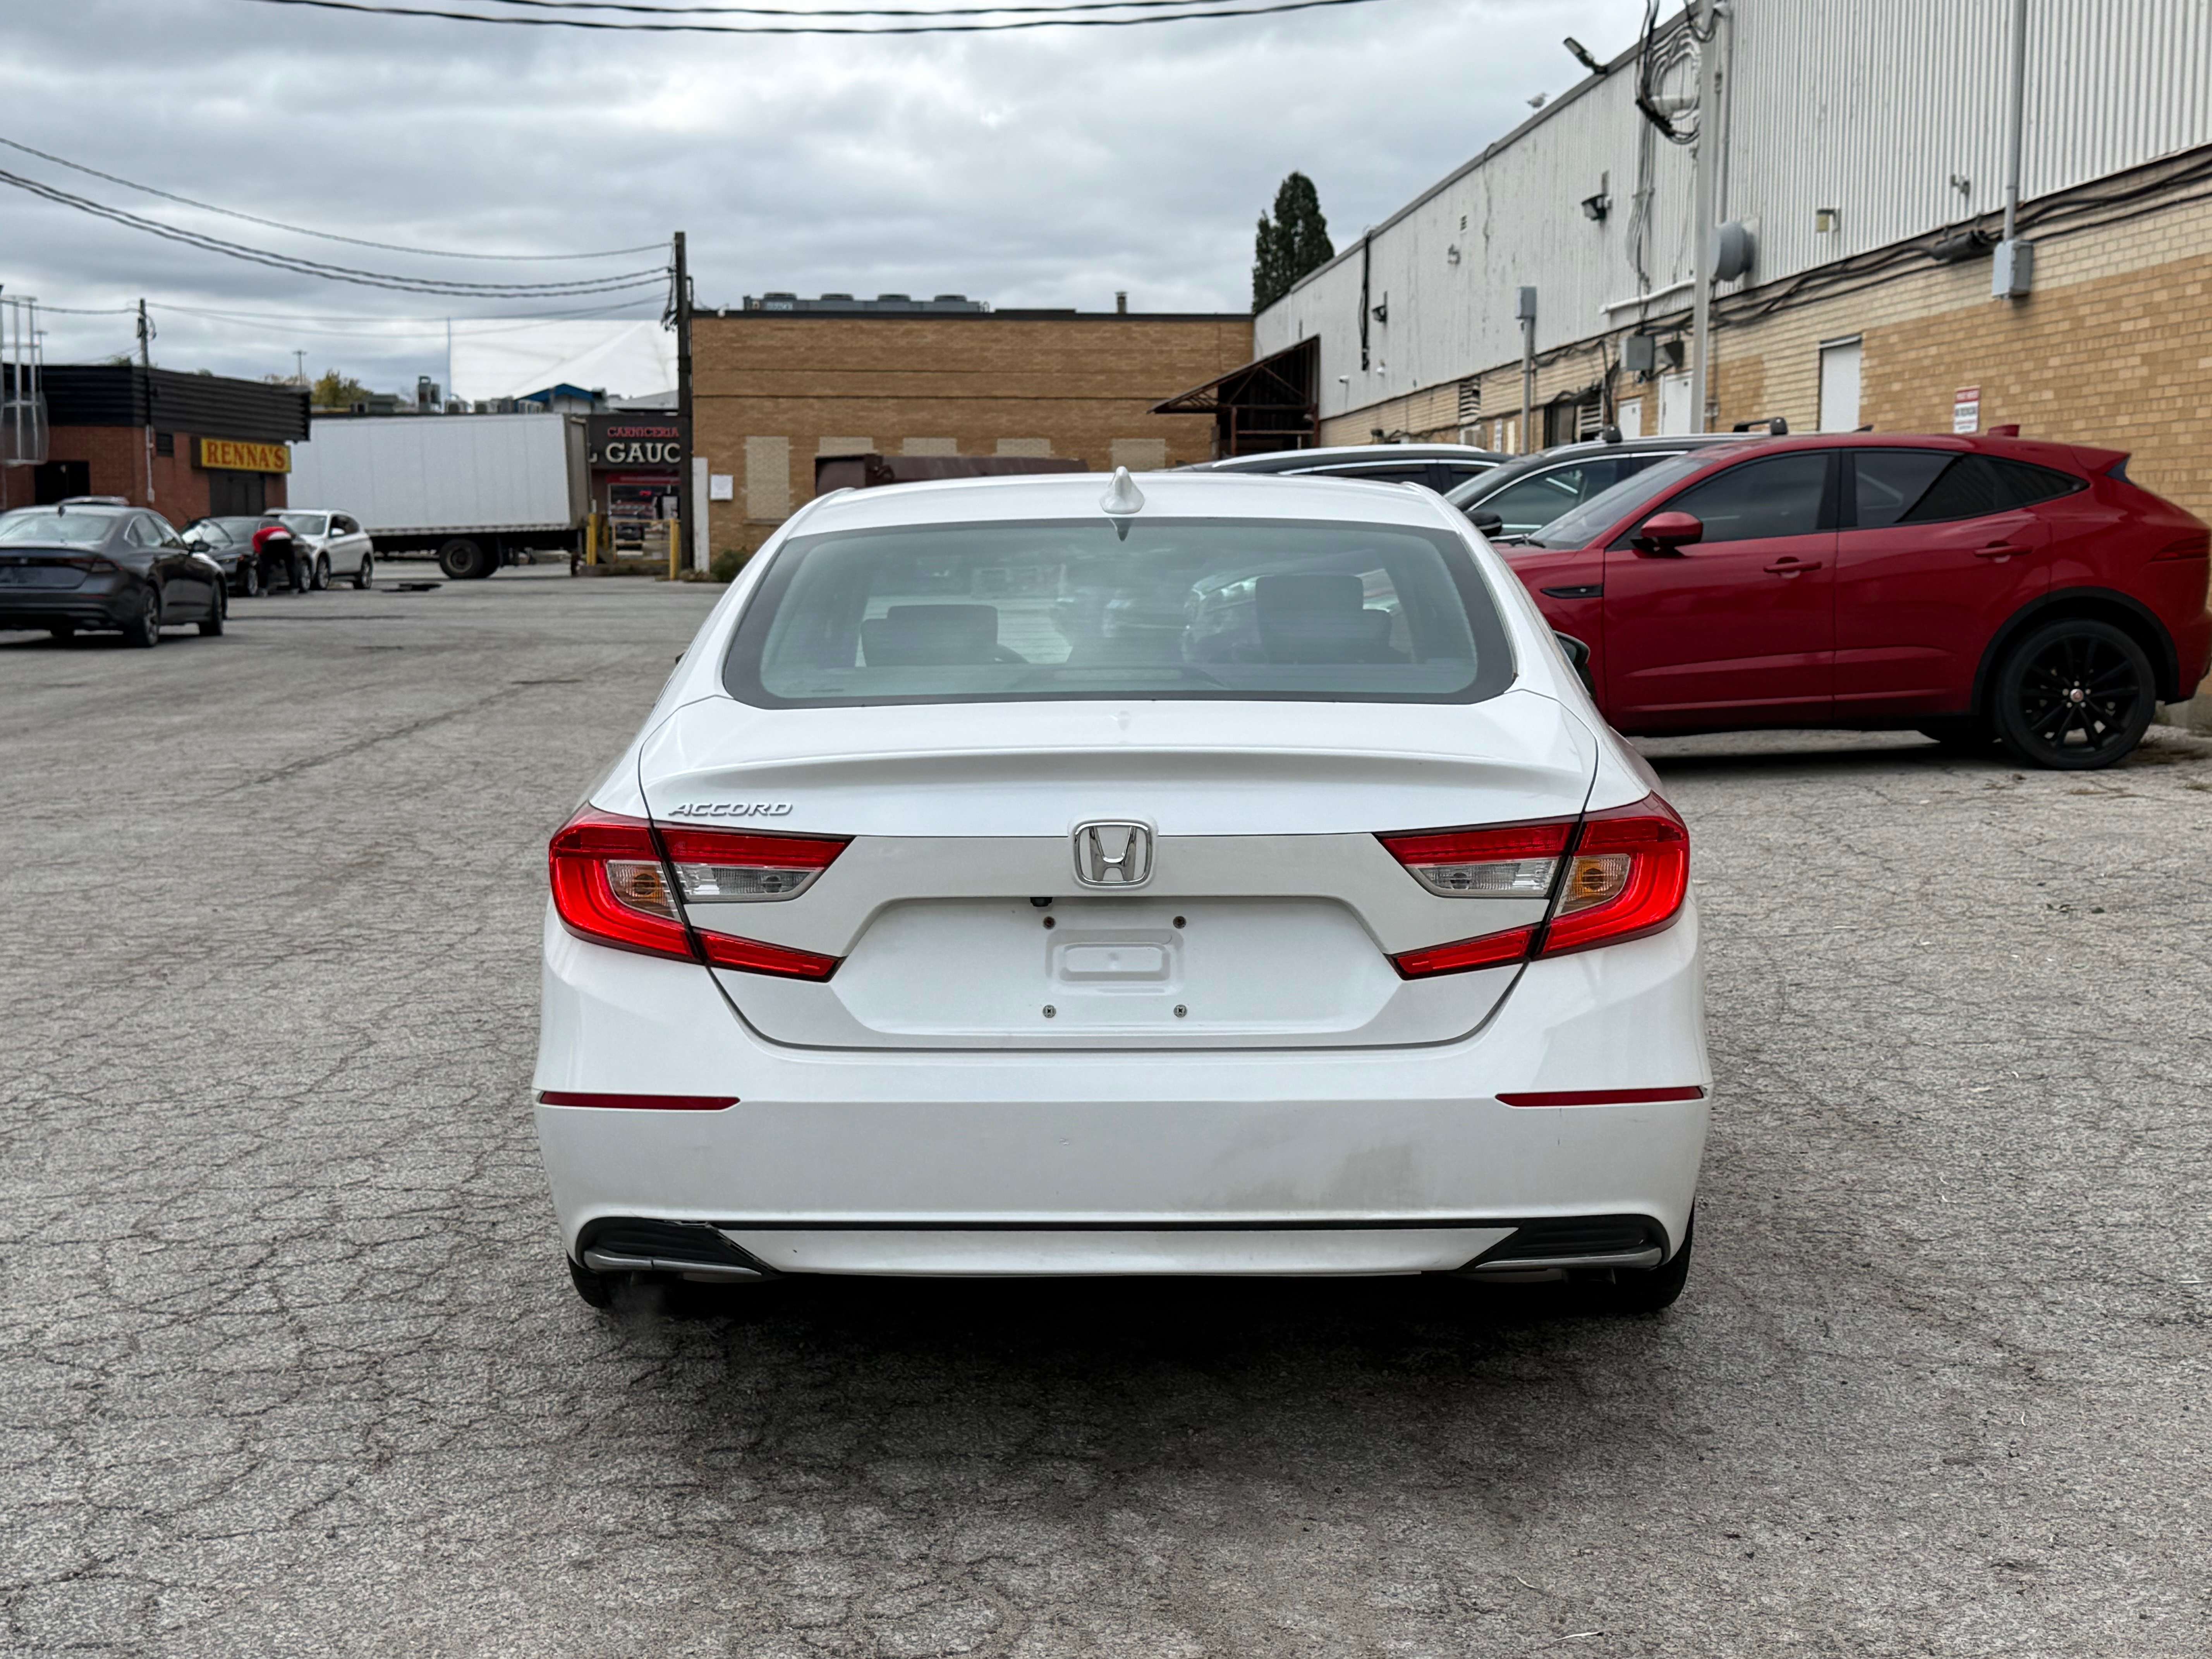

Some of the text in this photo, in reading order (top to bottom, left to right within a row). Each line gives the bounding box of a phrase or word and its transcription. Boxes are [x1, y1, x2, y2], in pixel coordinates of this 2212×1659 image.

[607, 427, 680, 438] CARNICERIA
[207, 441, 285, 469] RENNA'S
[605, 442, 681, 463] GAUC
[668, 802, 793, 816] ACCORD
